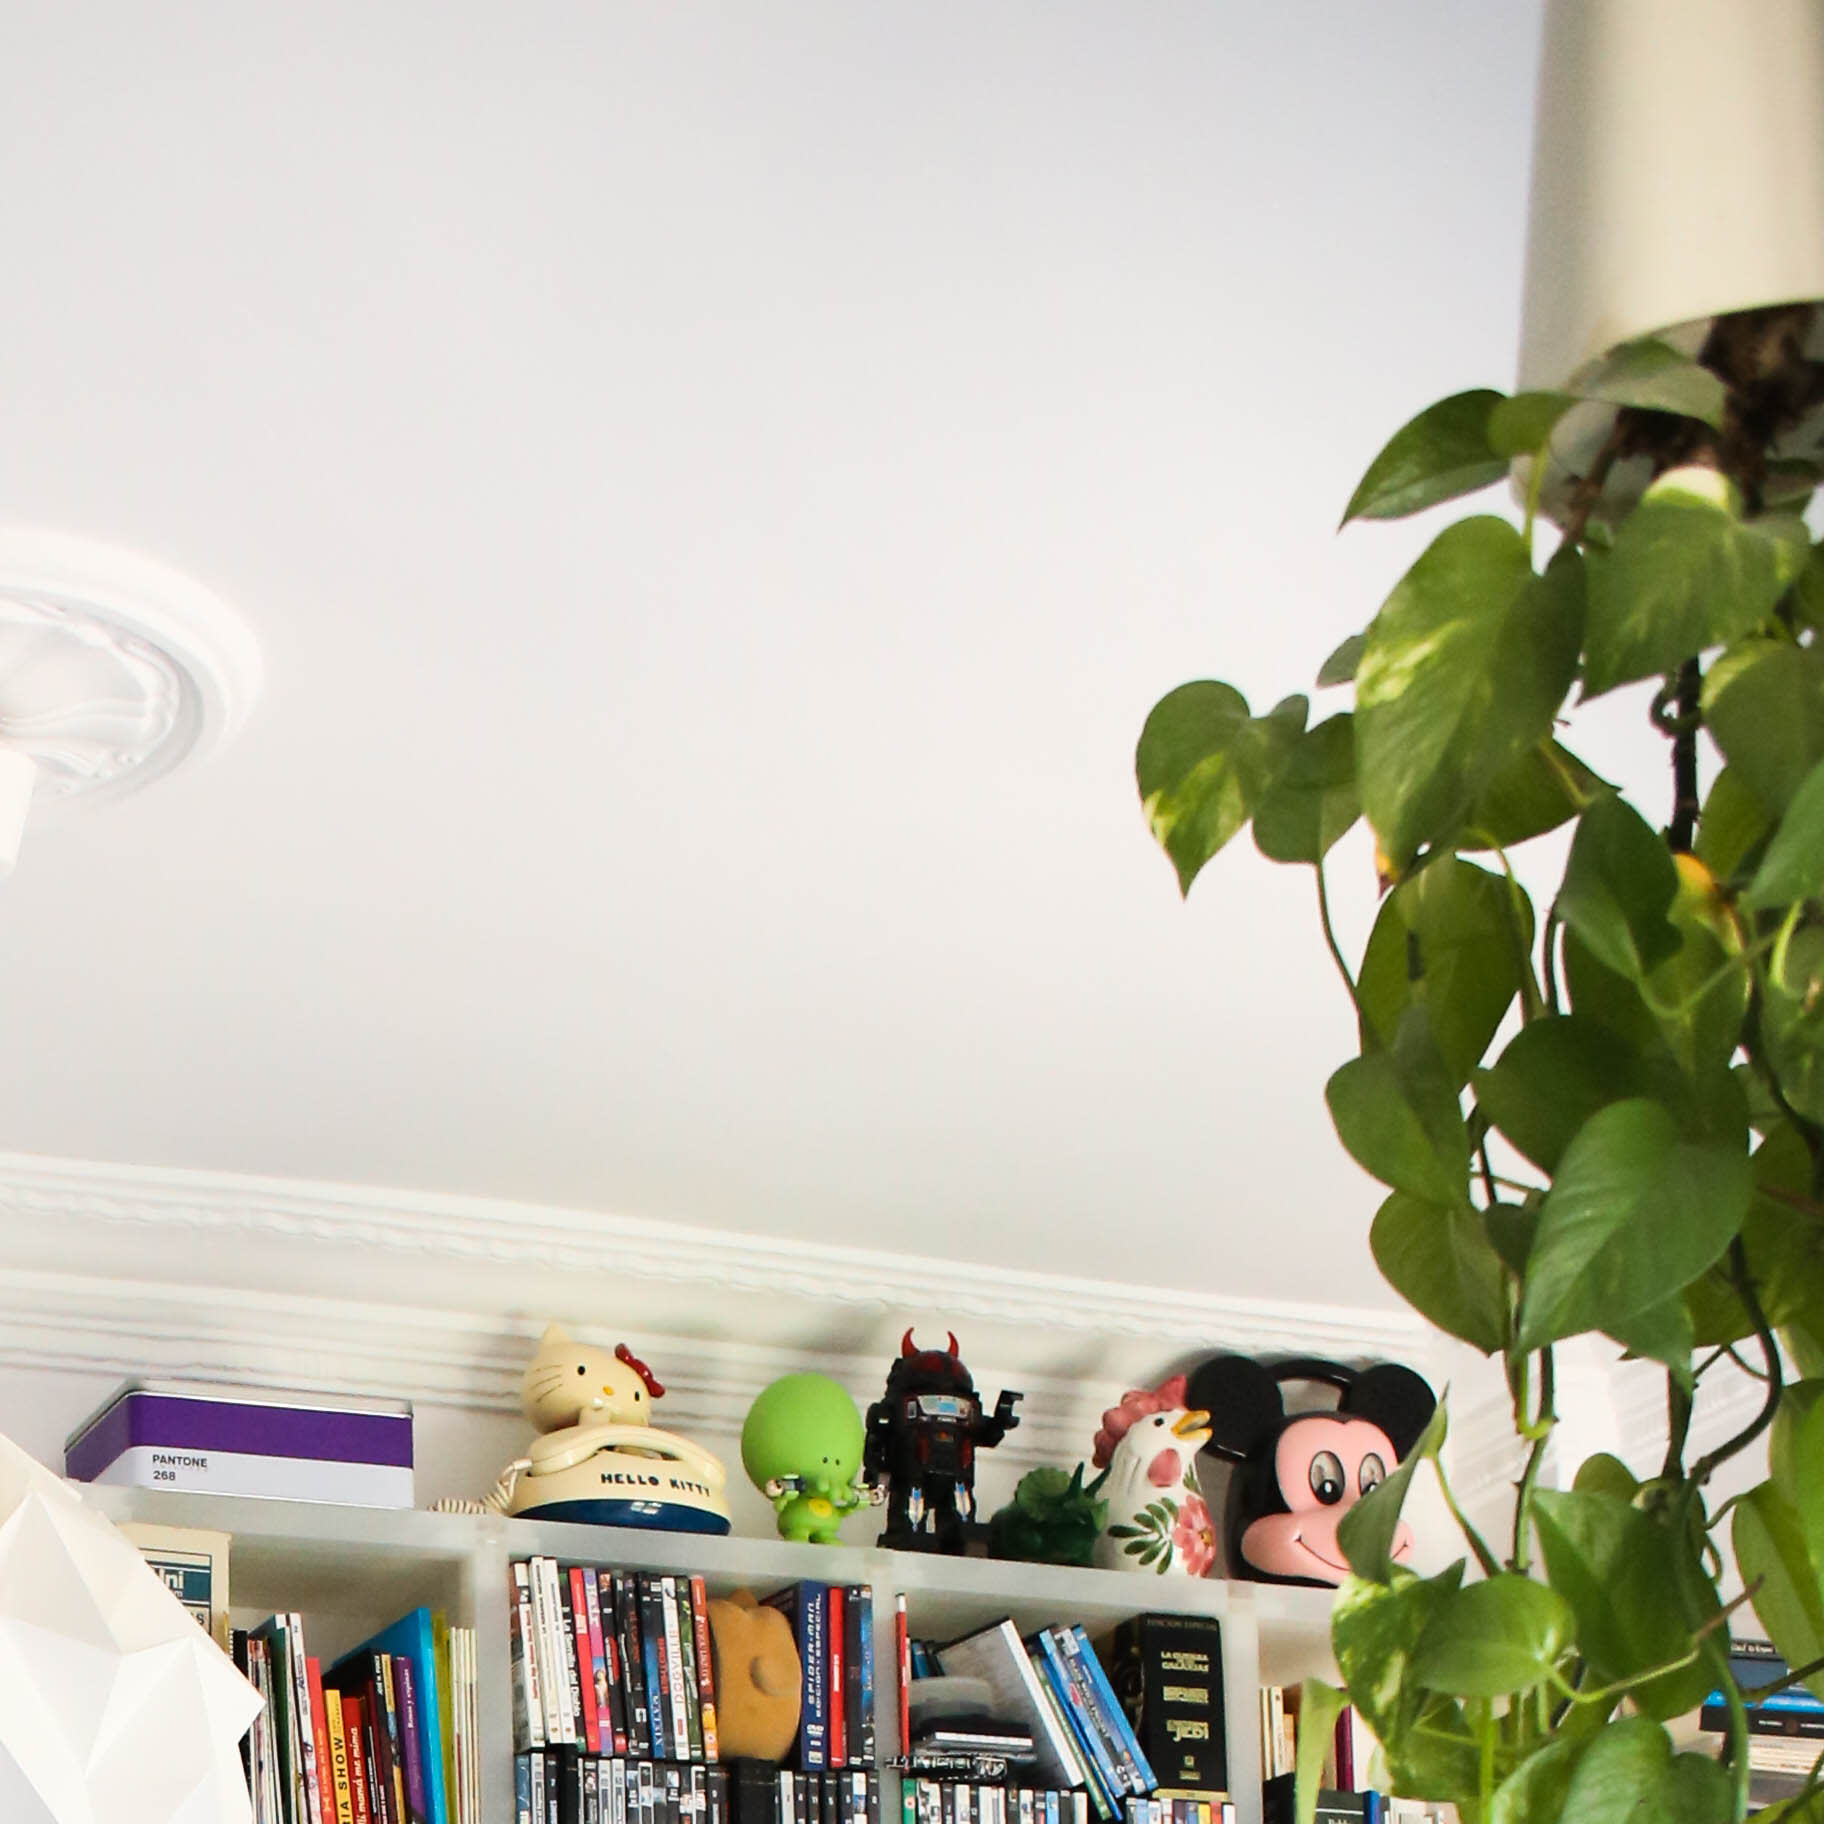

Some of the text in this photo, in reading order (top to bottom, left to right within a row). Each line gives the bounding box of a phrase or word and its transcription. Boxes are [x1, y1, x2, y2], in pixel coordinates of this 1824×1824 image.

[152, 1454, 207, 1467] PANTONE
[153, 1470, 176, 1481] 268
[601, 1473, 711, 1497] HELLO KITTY
[667, 1628, 685, 1705] DOGVILLE
[348, 1726, 359, 1757] mima
[333, 1736, 348, 1792] SHOW
[350, 1758, 361, 1777] me
[349, 1778, 366, 1814] mamá
